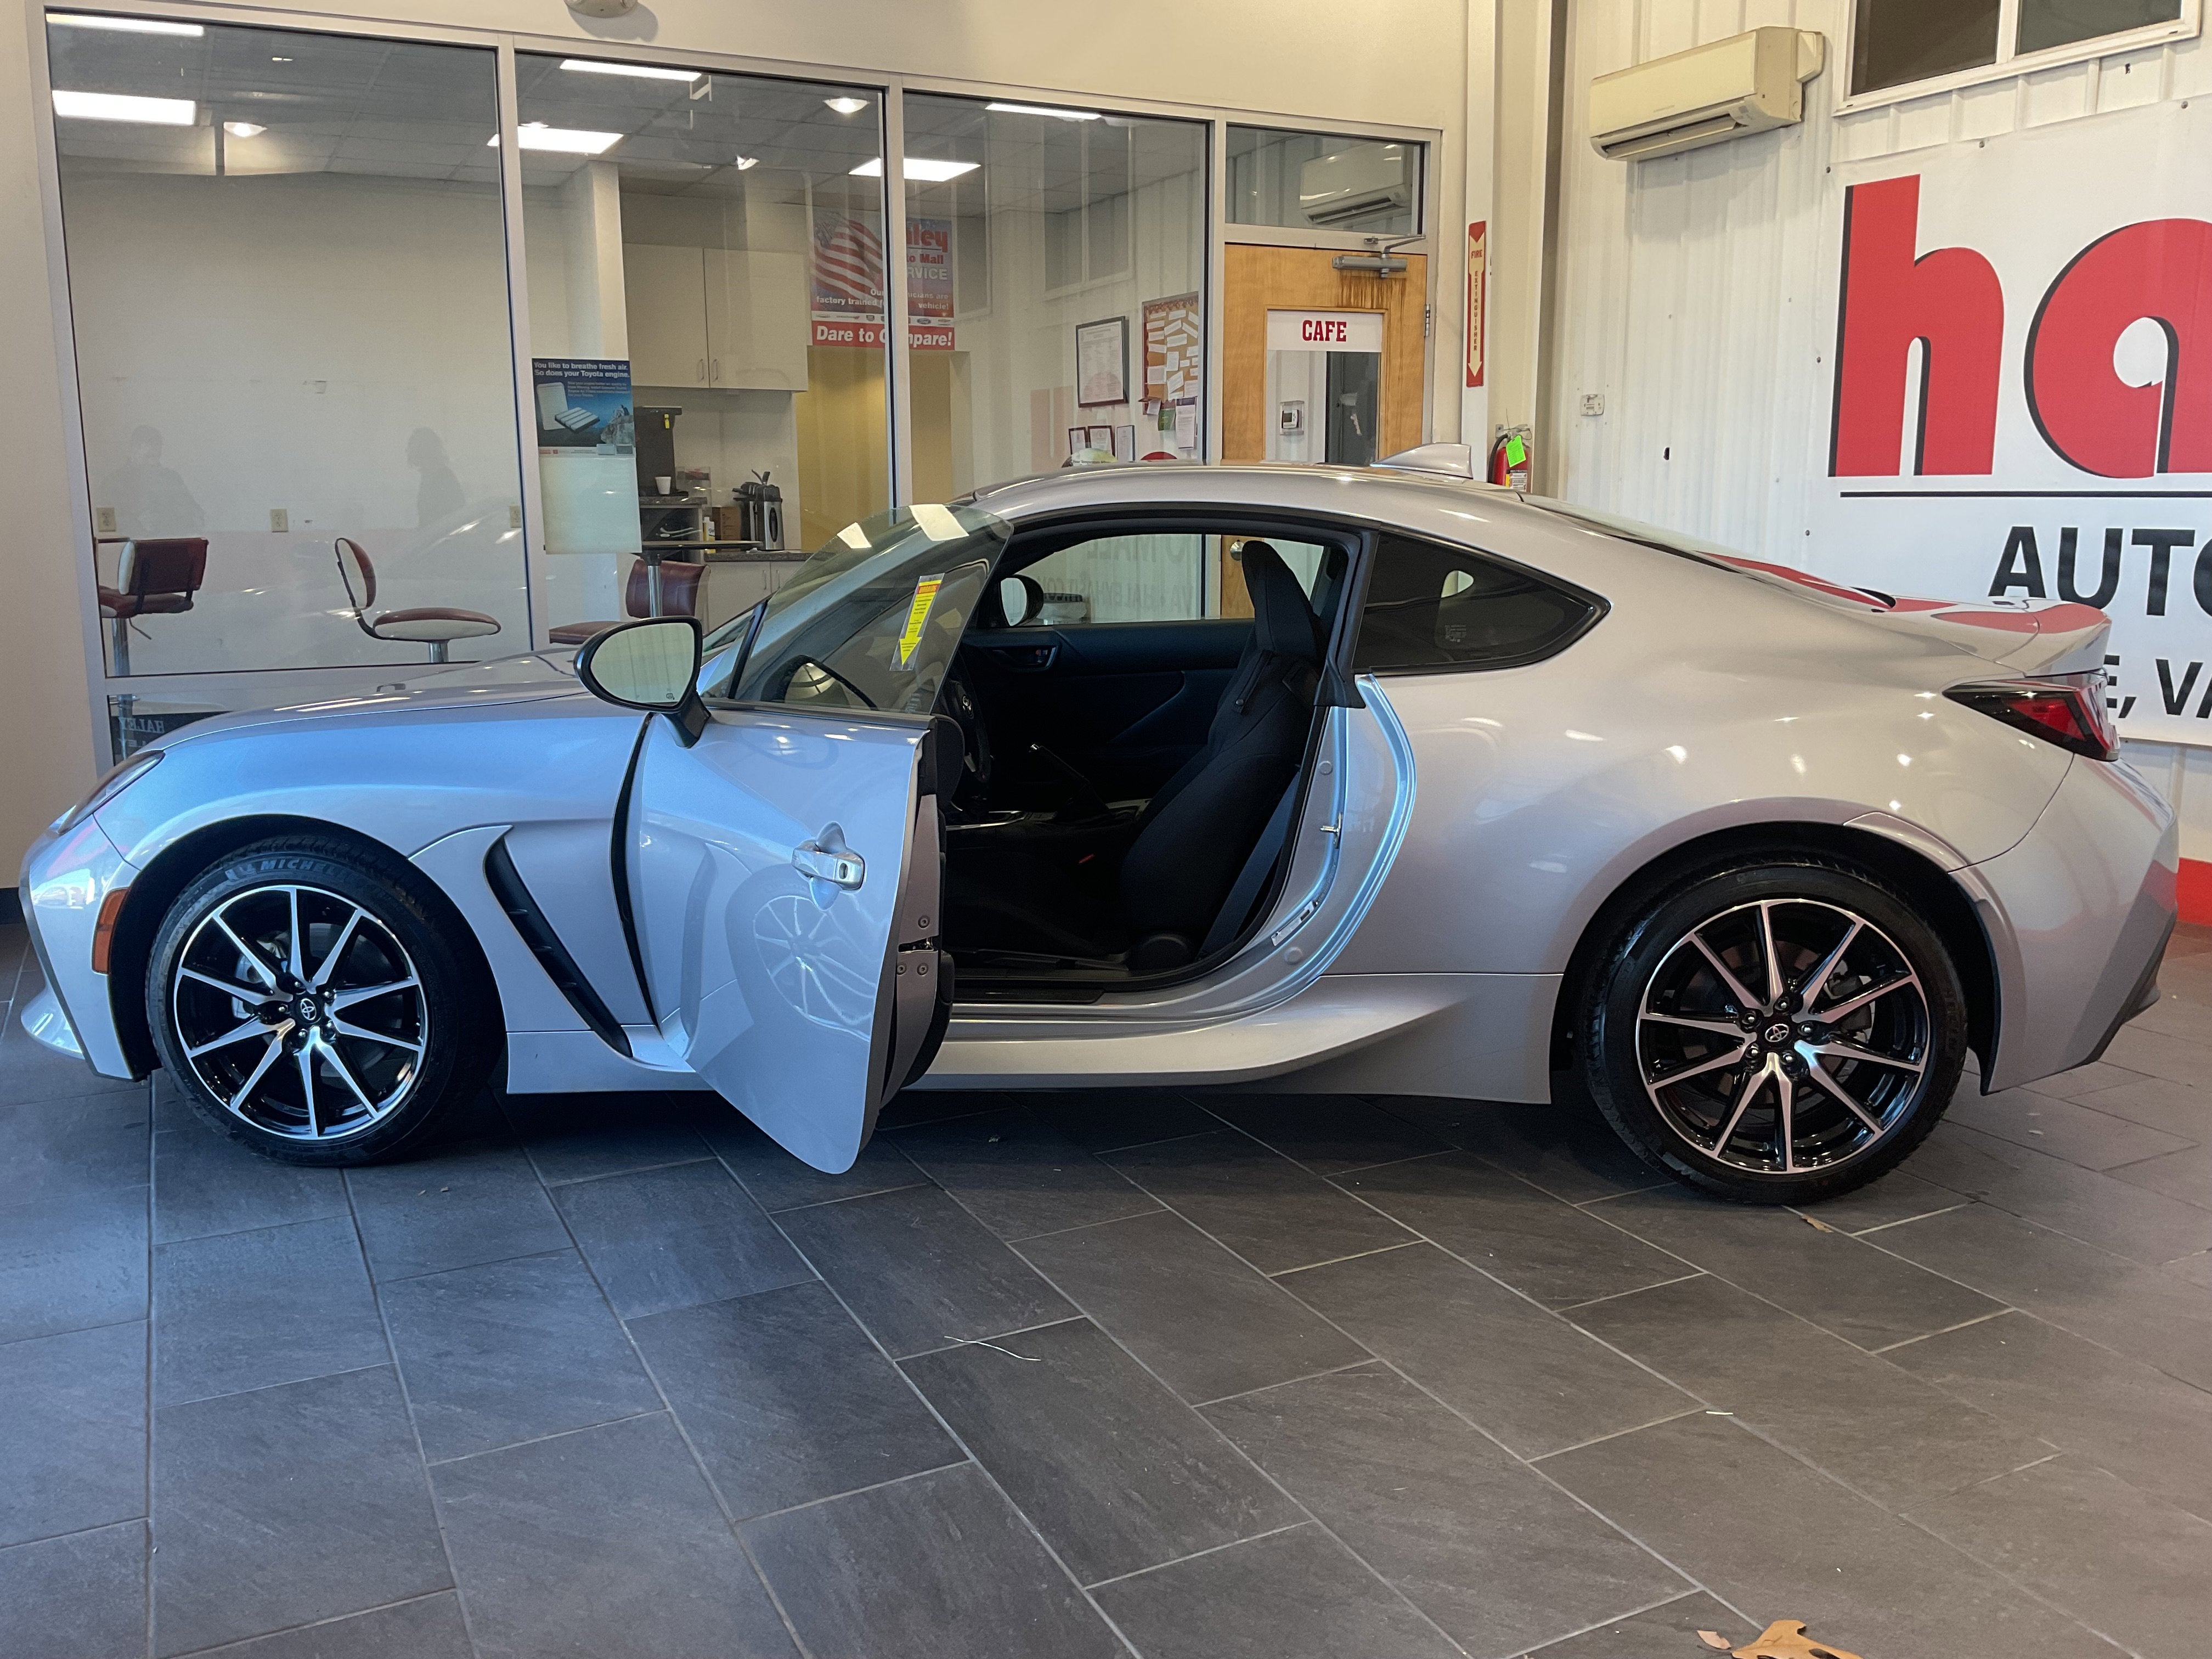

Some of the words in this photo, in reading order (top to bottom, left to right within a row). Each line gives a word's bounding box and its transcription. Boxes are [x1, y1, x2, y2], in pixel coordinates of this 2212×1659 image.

[907, 222, 948, 253] ley
[920, 254, 944, 264] Mall
[1471, 250, 1482, 259] FIRE
[907, 267, 948, 280] RVICE
[816, 296, 846, 306] factory
[848, 297, 877, 306] trained
[918, 302, 949, 310] vehicle!
[816, 325, 854, 342] Dare
[859, 328, 874, 343] to
[1302, 320, 1347, 342] CAFE
[1988, 526, 2212, 619] AUT
